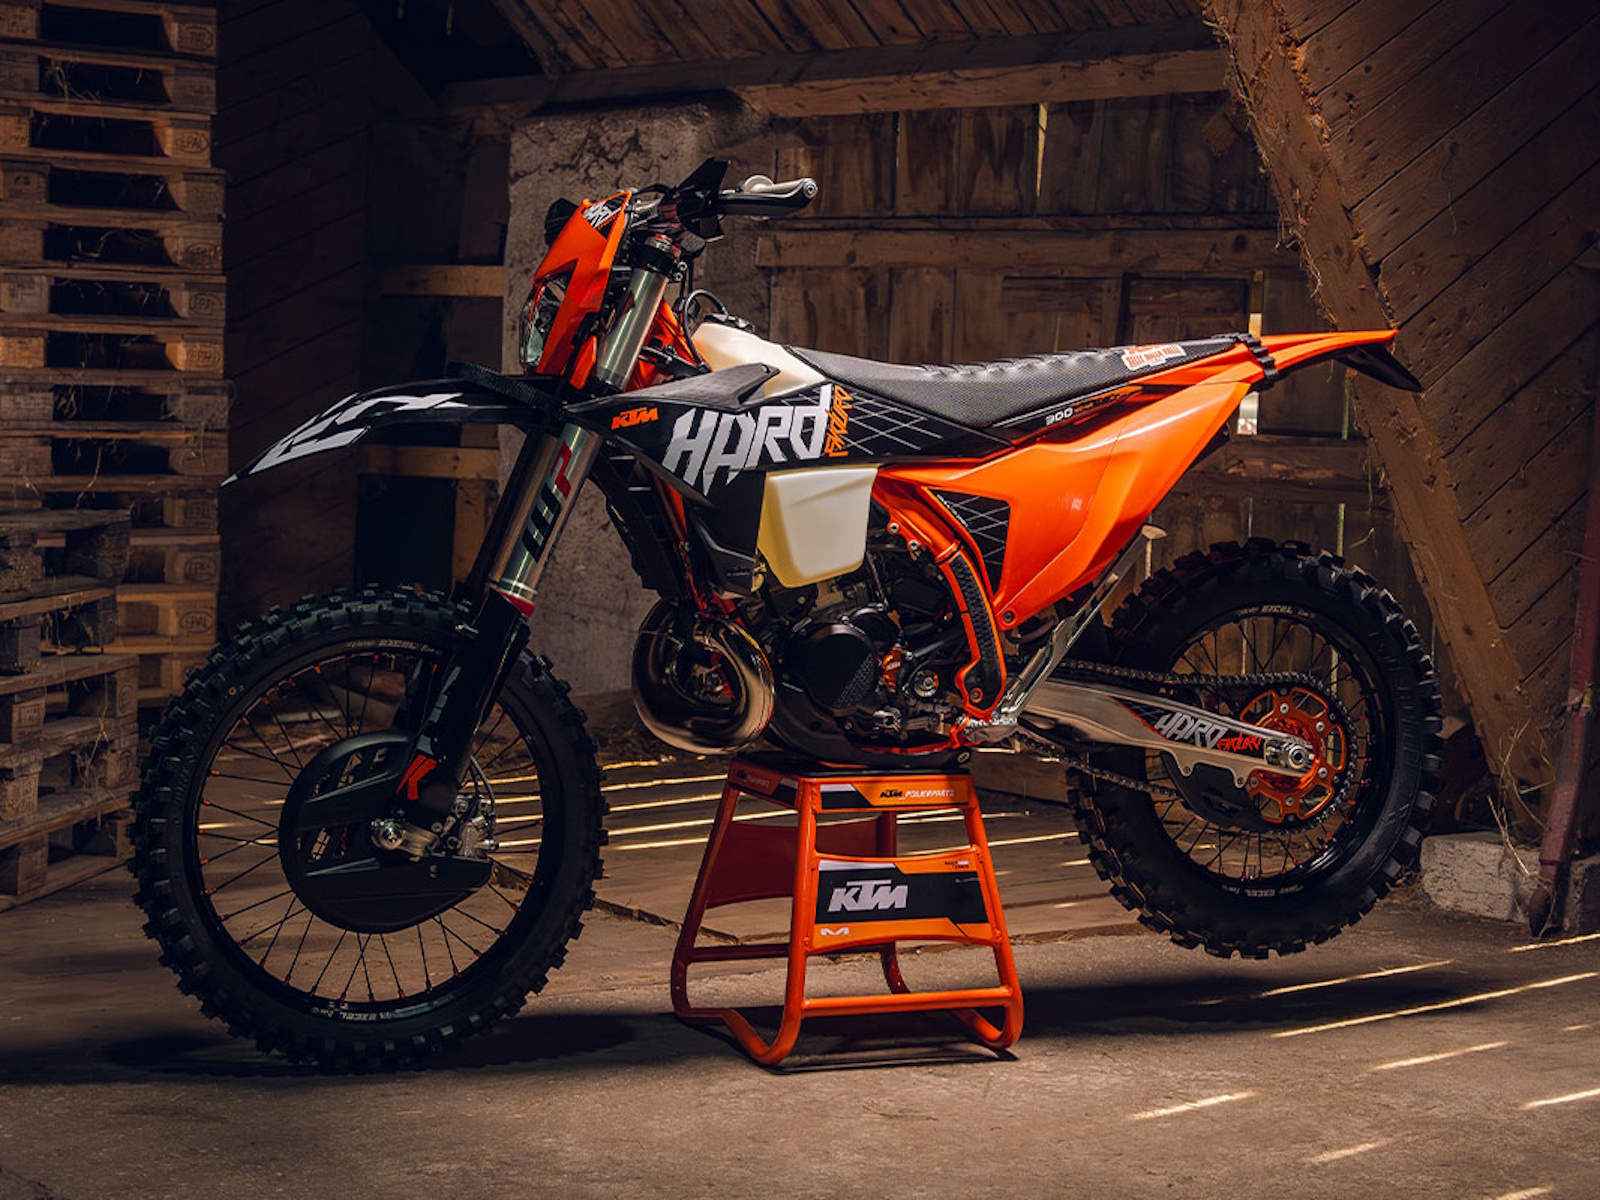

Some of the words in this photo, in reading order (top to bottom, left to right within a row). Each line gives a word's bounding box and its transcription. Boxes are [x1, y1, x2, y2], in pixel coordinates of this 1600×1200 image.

[611, 407, 659, 430] KTM
[880, 789, 903, 799] KTM
[827, 879, 909, 913] KTM
